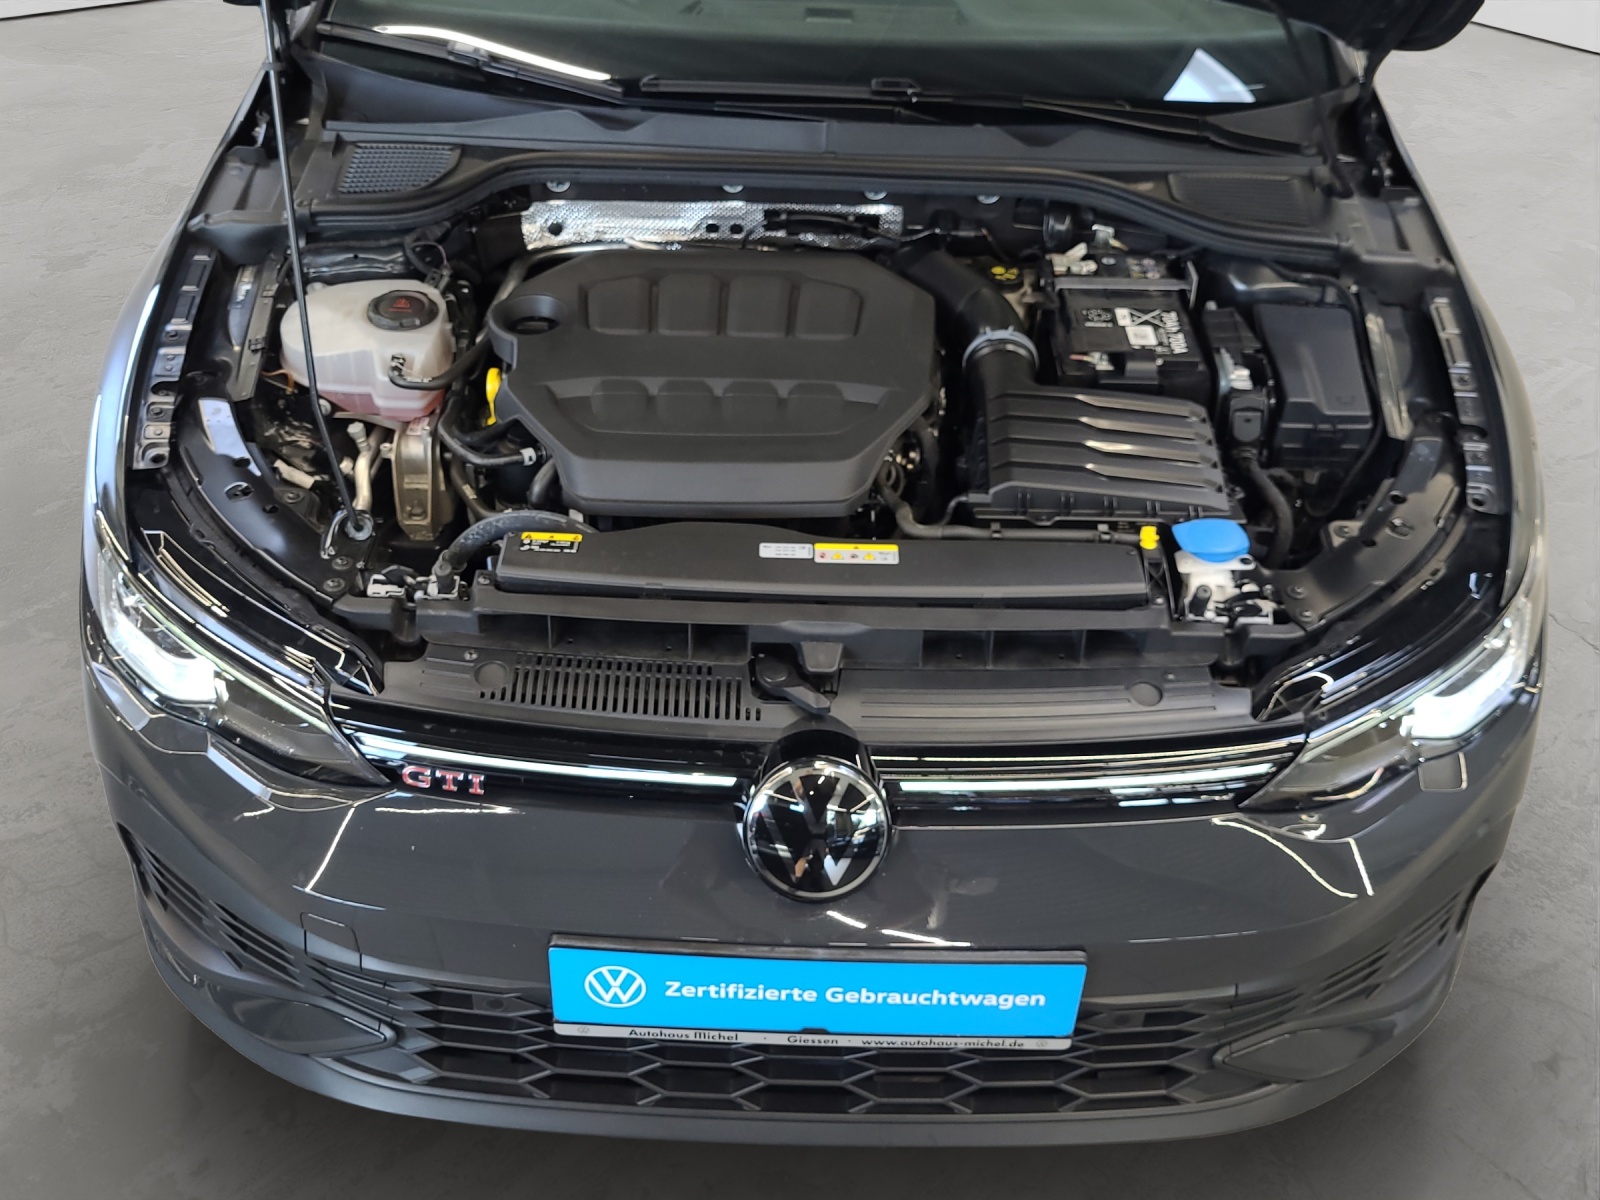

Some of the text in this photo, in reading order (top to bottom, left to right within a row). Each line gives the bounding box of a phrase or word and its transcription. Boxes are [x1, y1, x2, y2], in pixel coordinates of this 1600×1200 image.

[401, 764, 485, 796] GTI
[664, 979, 1046, 1011] Zertifizierte Gebrauchtwagen
[628, 1028, 690, 1040] Autohaus
[694, 1030, 739, 1042] Michel
[787, 1034, 839, 1046] Giessen
[861, 1037, 1025, 1049] www.autohaus-michel.de
